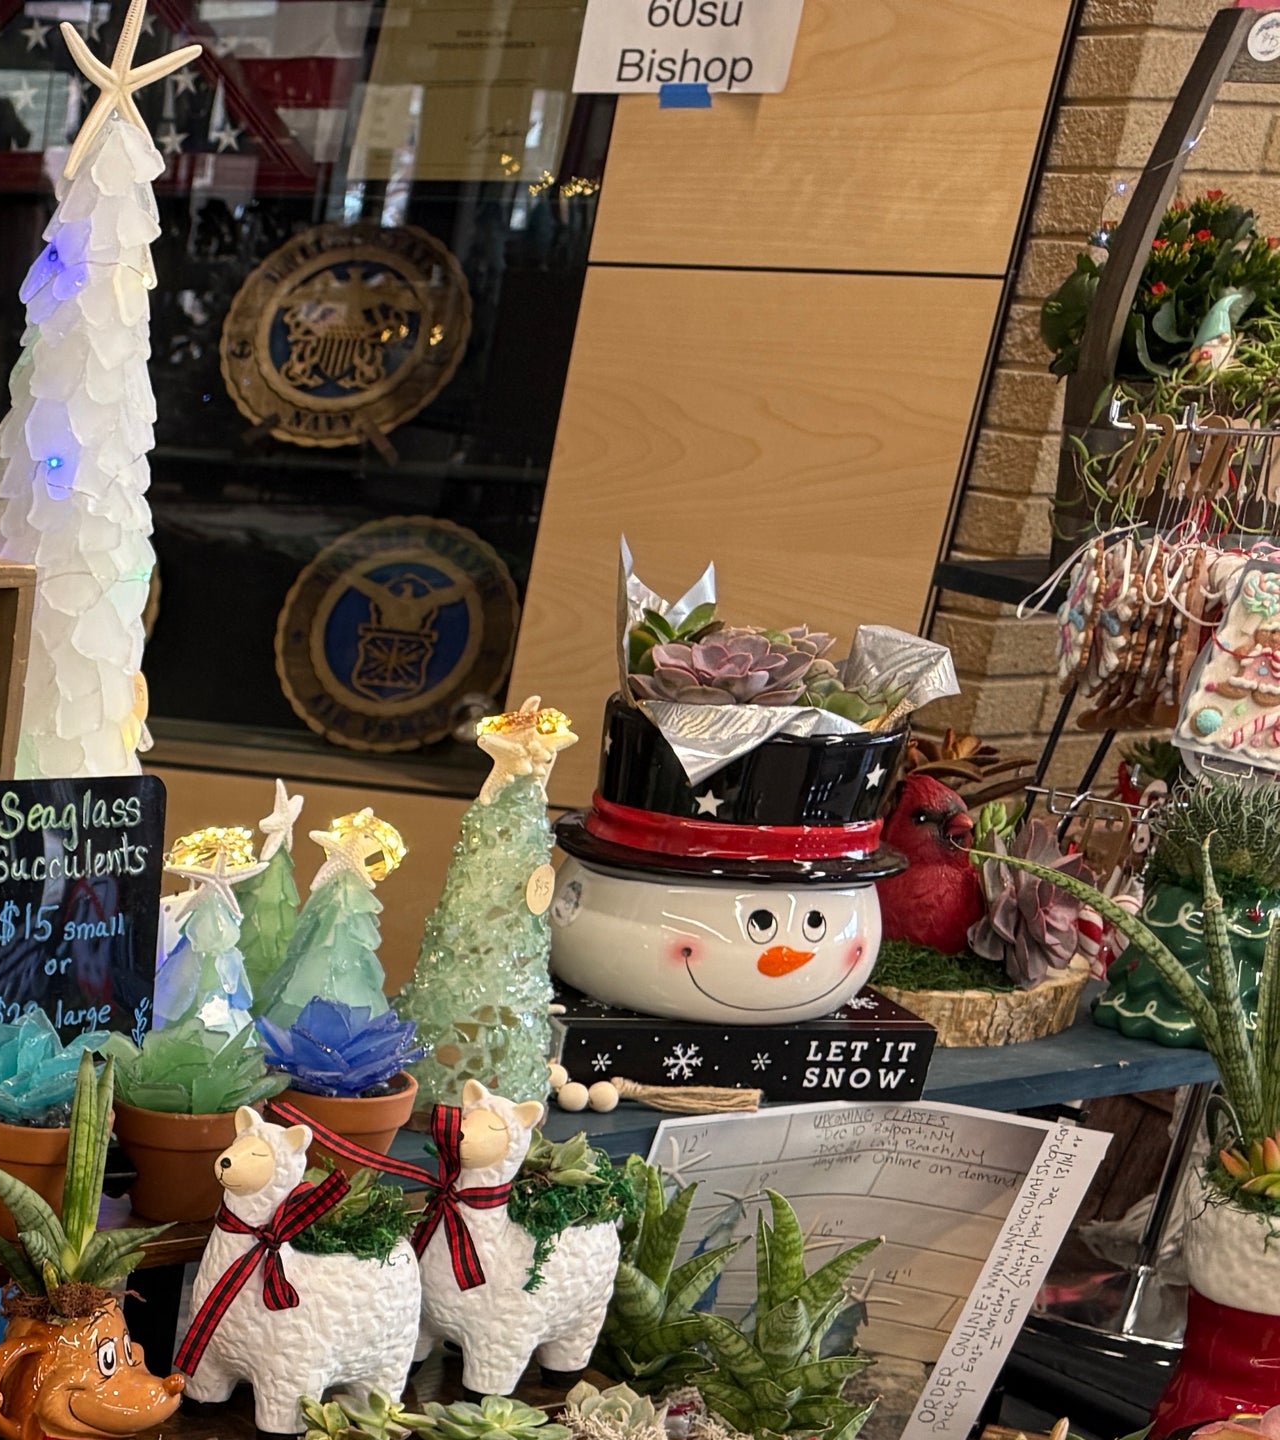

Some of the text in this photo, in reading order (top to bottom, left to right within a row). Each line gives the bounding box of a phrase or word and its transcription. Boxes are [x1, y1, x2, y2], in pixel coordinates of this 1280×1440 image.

[616, 48, 754, 92] Bishop
[63, 913, 124, 940] small
[44, 957, 73, 976] or
[55, 999, 111, 1033] large
[806, 1041, 916, 1062] LET IT
[802, 1067, 906, 1089] SNOW
[882, 1108, 950, 1128] CLASSES
[929, 1164, 952, 1175] on
[1037, 1186, 1060, 1208] Dec
[1001, 1297, 1020, 1324] can
[918, 1367, 960, 1424] ORDER
